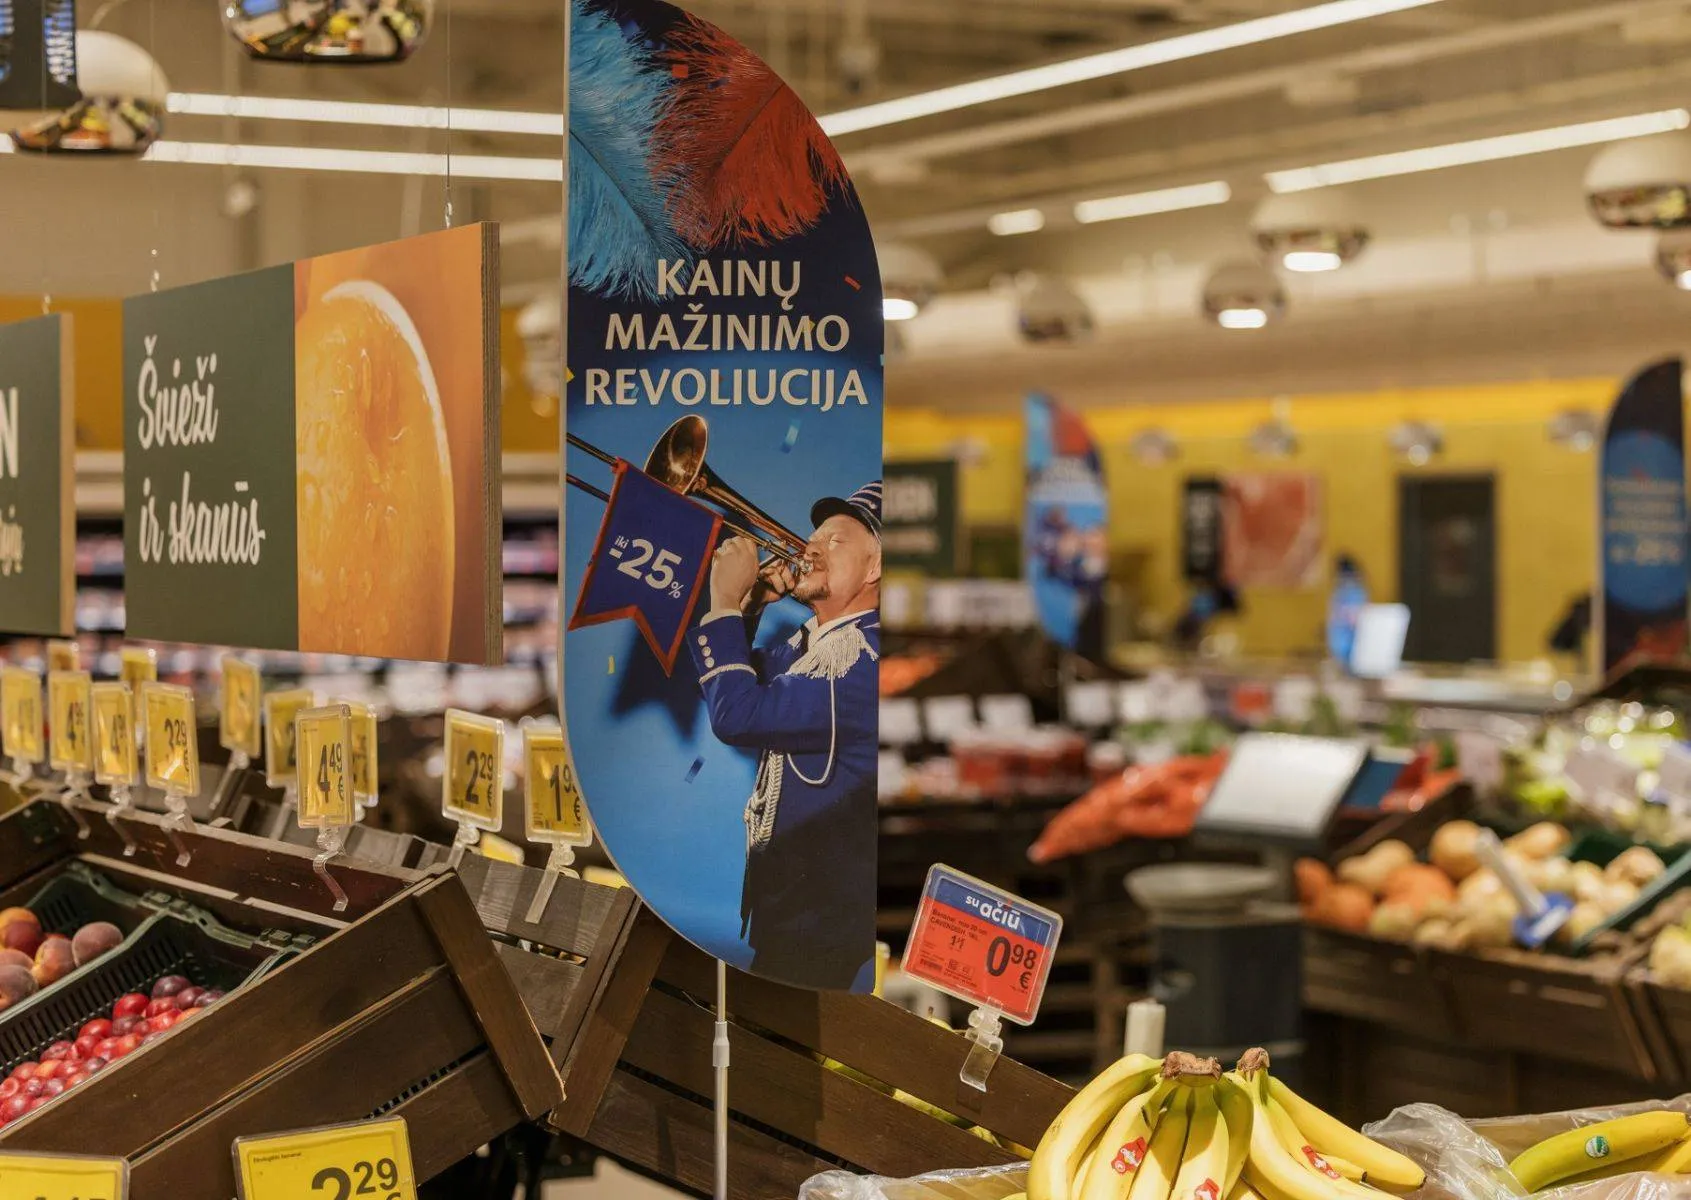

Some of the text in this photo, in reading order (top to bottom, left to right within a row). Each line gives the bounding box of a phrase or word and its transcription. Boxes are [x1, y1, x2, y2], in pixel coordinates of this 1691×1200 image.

[657, 258, 801, 311] KAINŲ
[604, 303, 851, 352] MAŽINIMO
[138, 335, 219, 450] Švieži
[584, 368, 869, 412] REVOLIUCIJA
[139, 471, 266, 565] ir skanūs
[614, 535, 630, 550] iki
[965, 893, 980, 909] su
[1019, 971, 1032, 990] €
